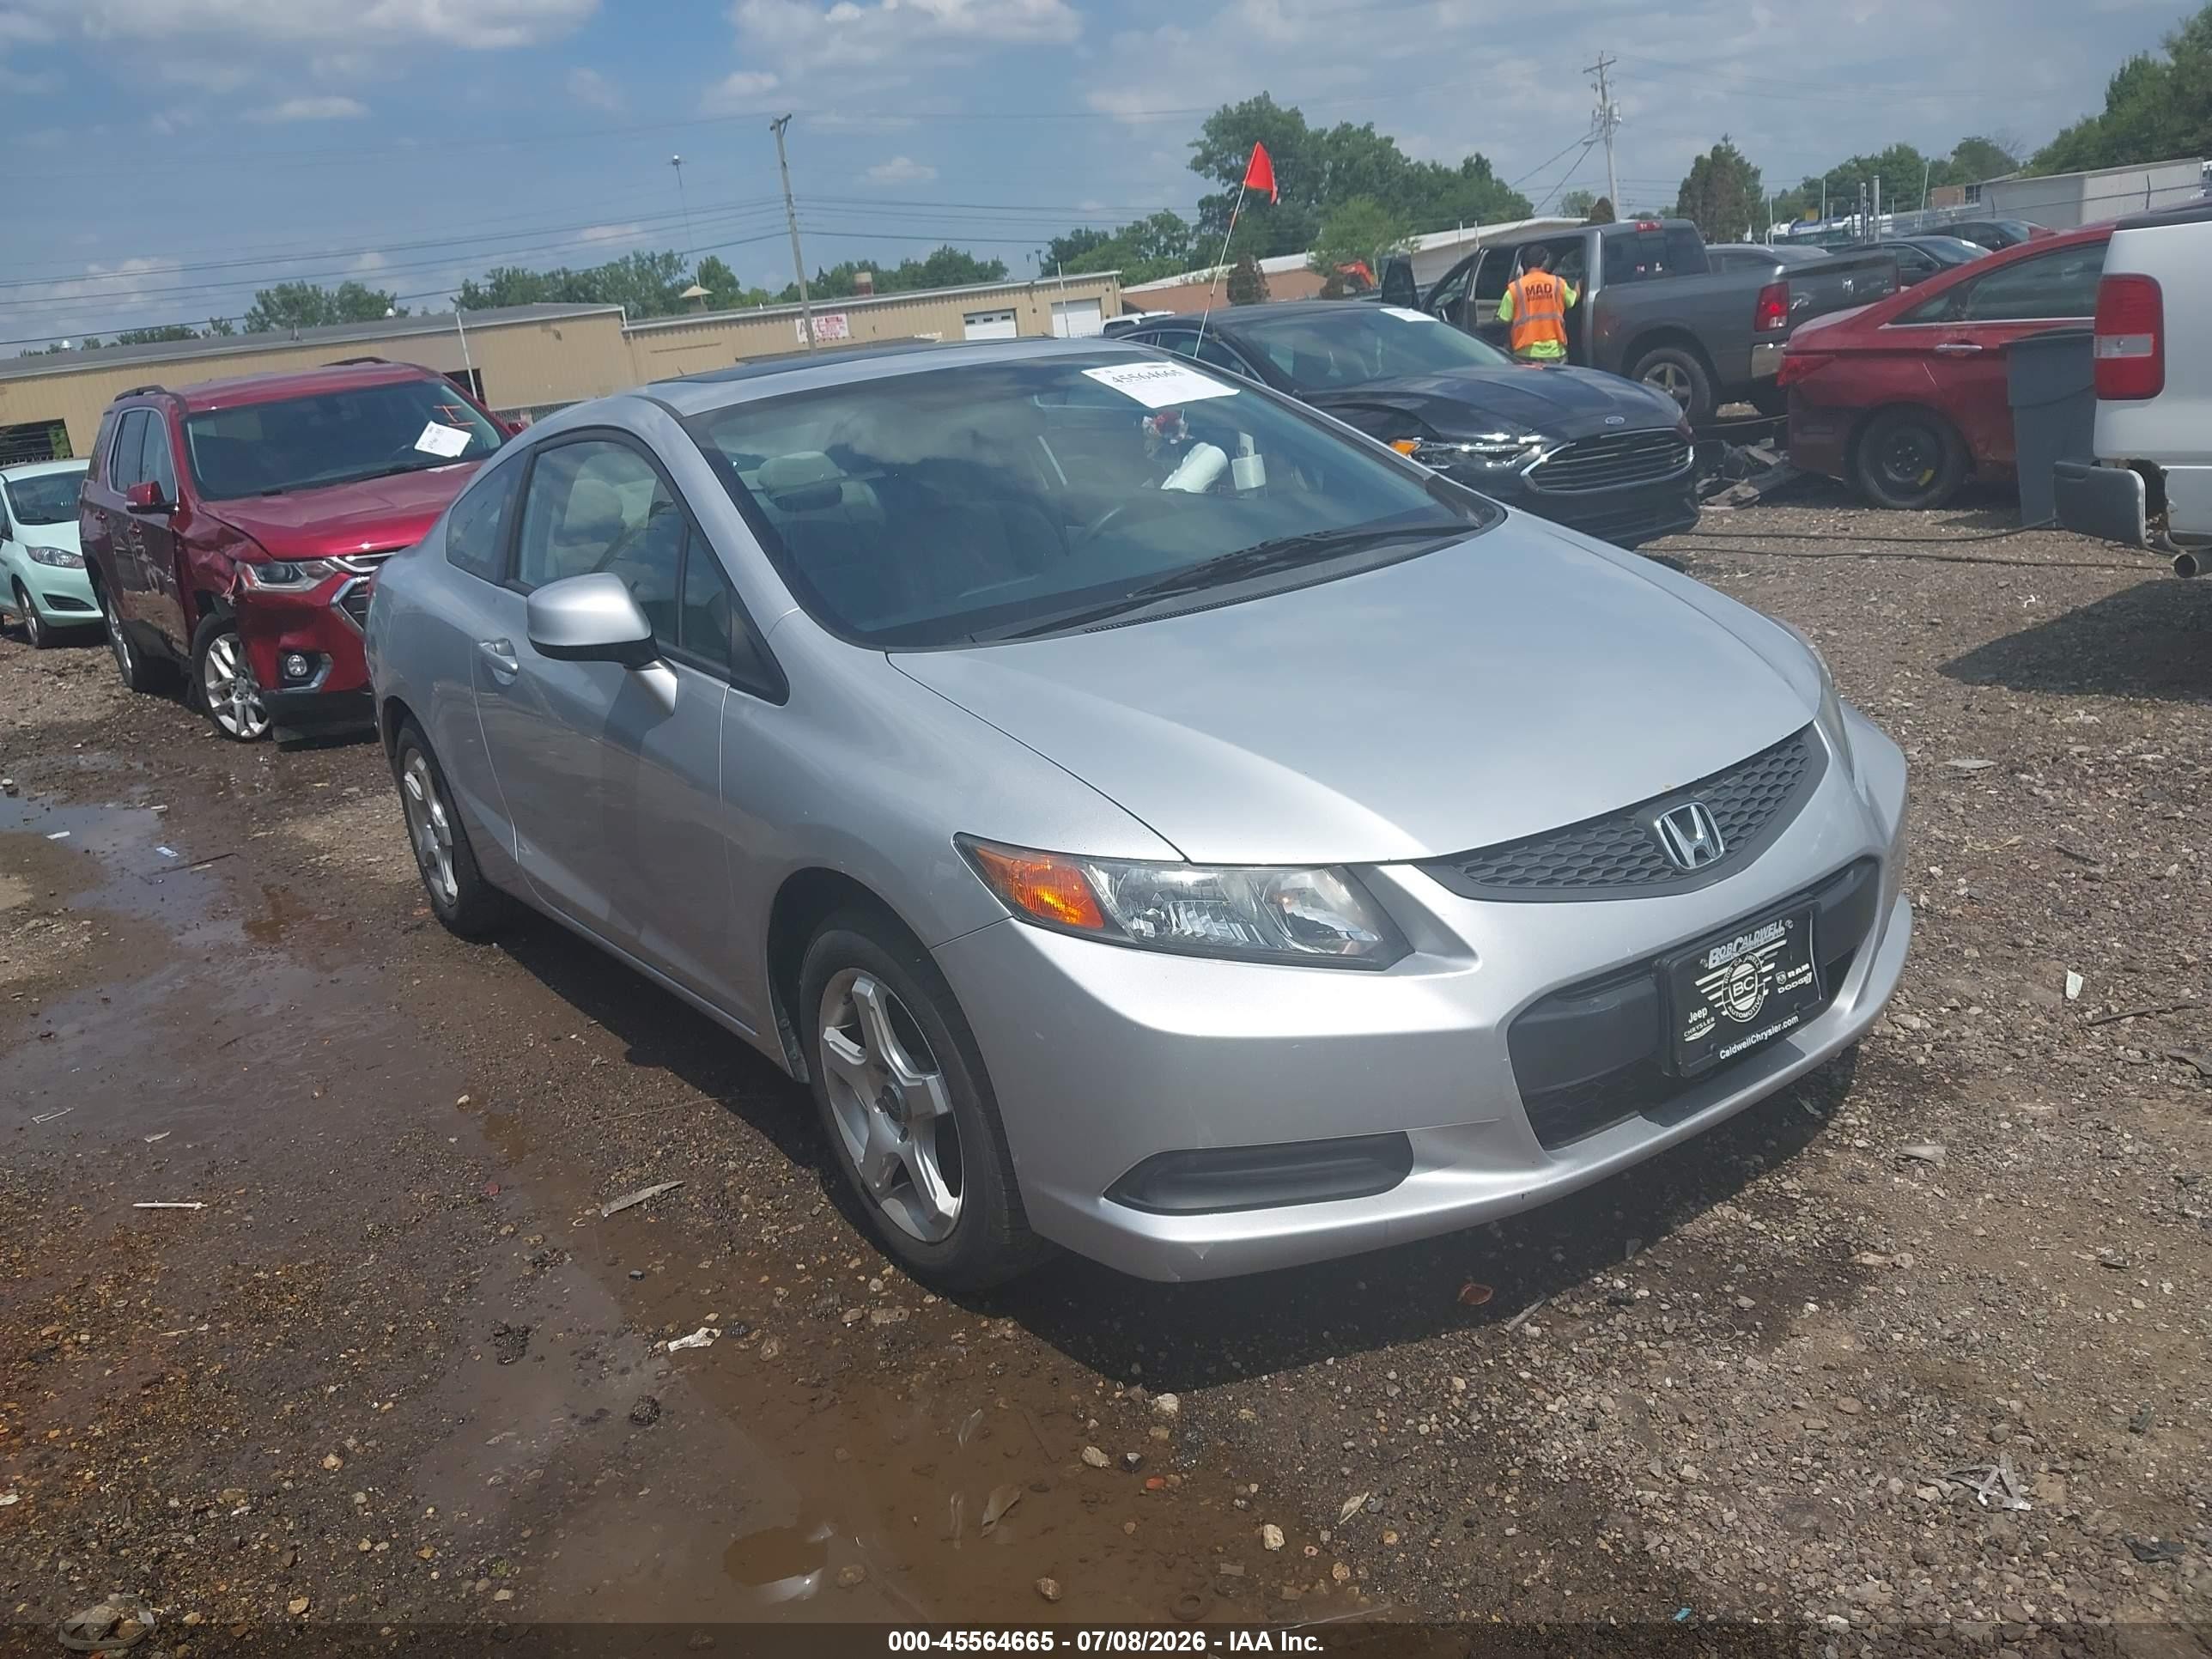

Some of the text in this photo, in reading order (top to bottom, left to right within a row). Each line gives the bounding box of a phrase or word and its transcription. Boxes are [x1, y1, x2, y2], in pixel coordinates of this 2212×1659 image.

[1525, 283, 1553, 296] MAD
[1112, 369, 1183, 383] 45564665
[1787, 963, 1810, 978] RAM
[1733, 976, 1754, 997] BC
[1778, 975, 1808, 994] DODGE
[1688, 1006, 1708, 1024] Jeep
[1728, 994, 1762, 1018] AUTOMOTIVE
[1683, 1016, 1716, 1037] CHRYSLER
[1719, 1015, 1800, 1060] CaldwellChrysler.com
